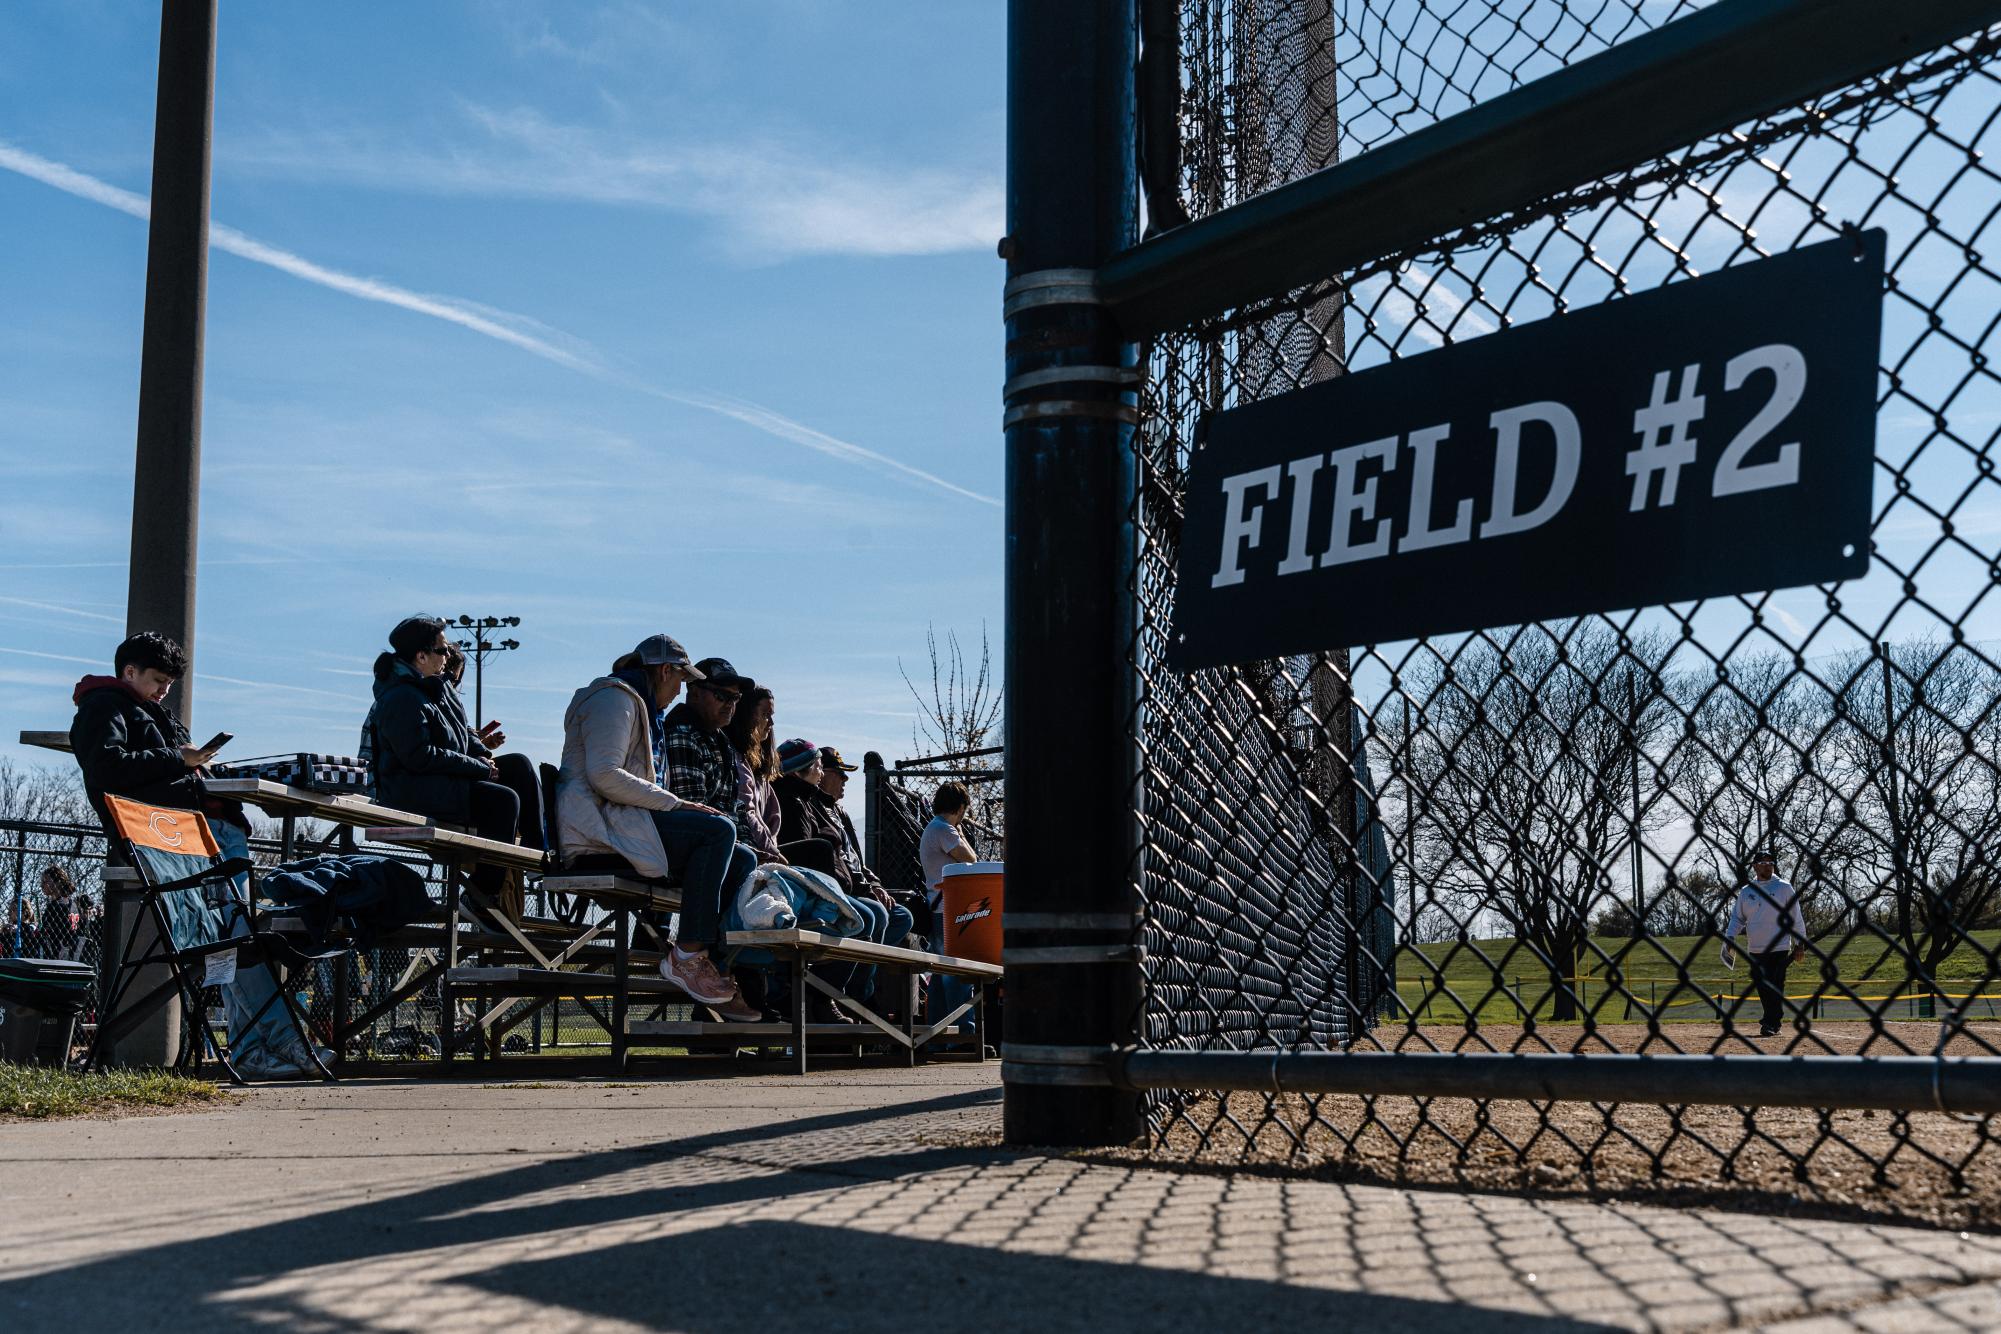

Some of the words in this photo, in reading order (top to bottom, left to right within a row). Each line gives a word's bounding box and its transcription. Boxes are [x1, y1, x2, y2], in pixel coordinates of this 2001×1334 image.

[1211, 400, 1582, 589] FIELD
[1625, 343, 1807, 512] #2
[149, 811, 182, 847] C
